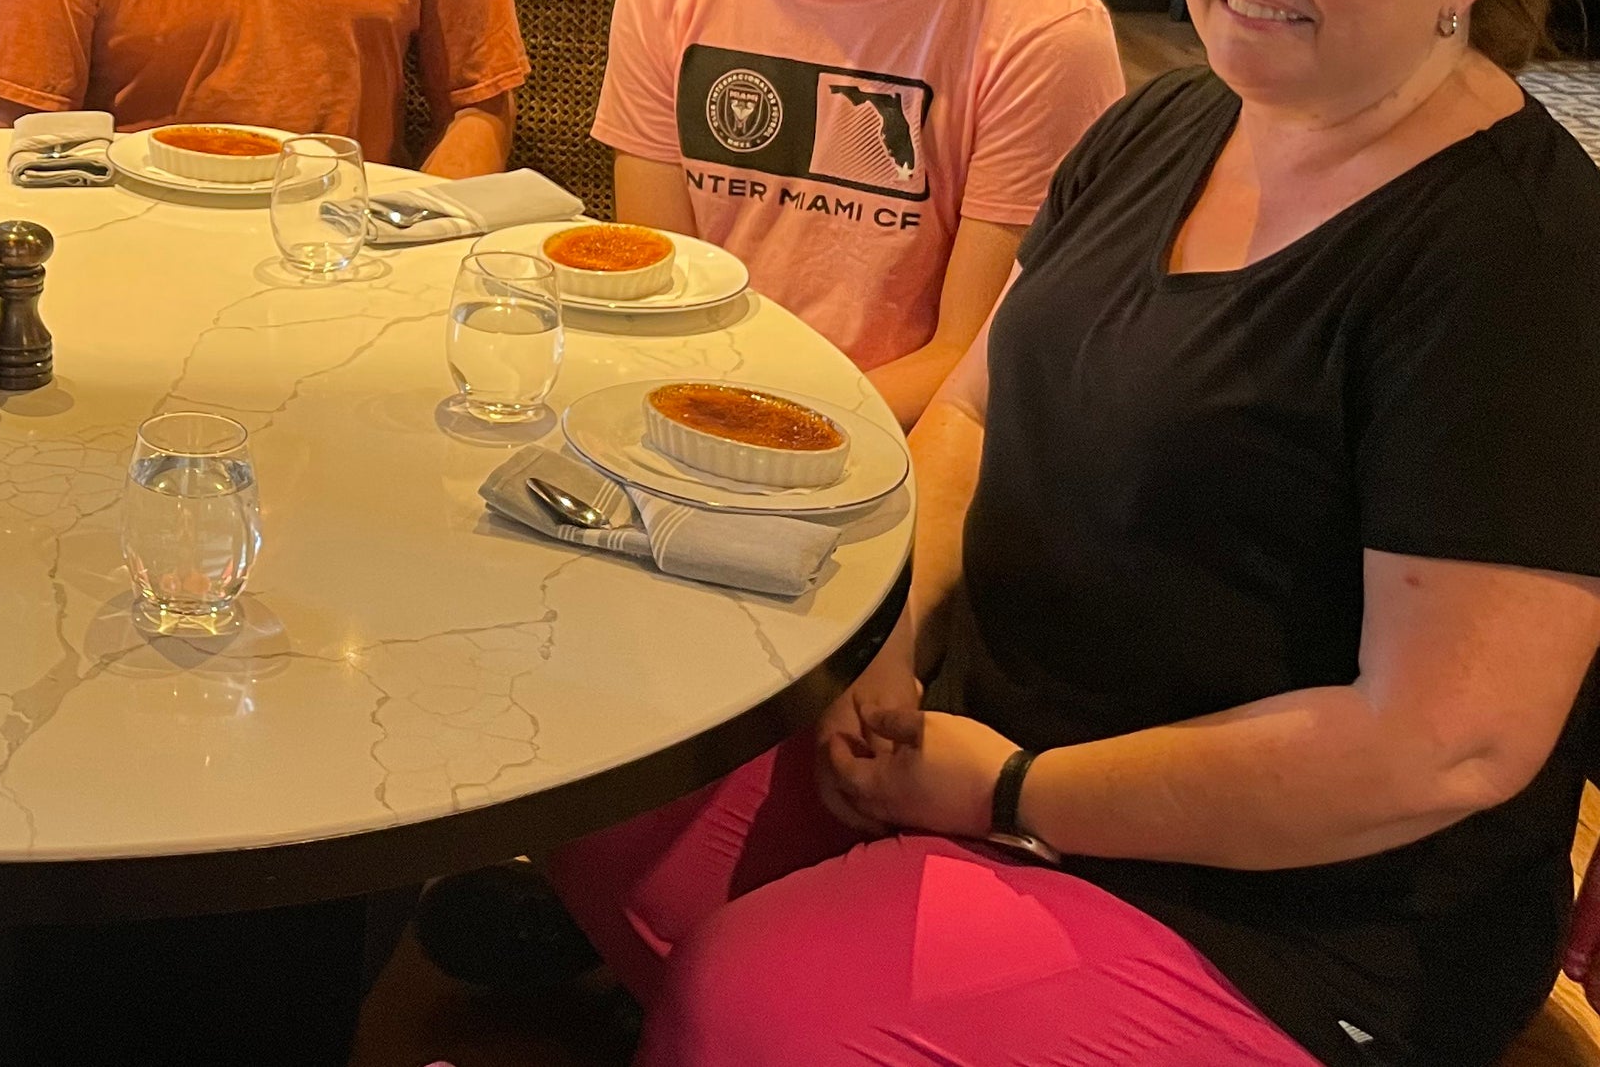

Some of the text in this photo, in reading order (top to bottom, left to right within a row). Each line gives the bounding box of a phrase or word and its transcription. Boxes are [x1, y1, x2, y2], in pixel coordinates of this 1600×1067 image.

[685, 169, 922, 230] NTER MIAMI CF
